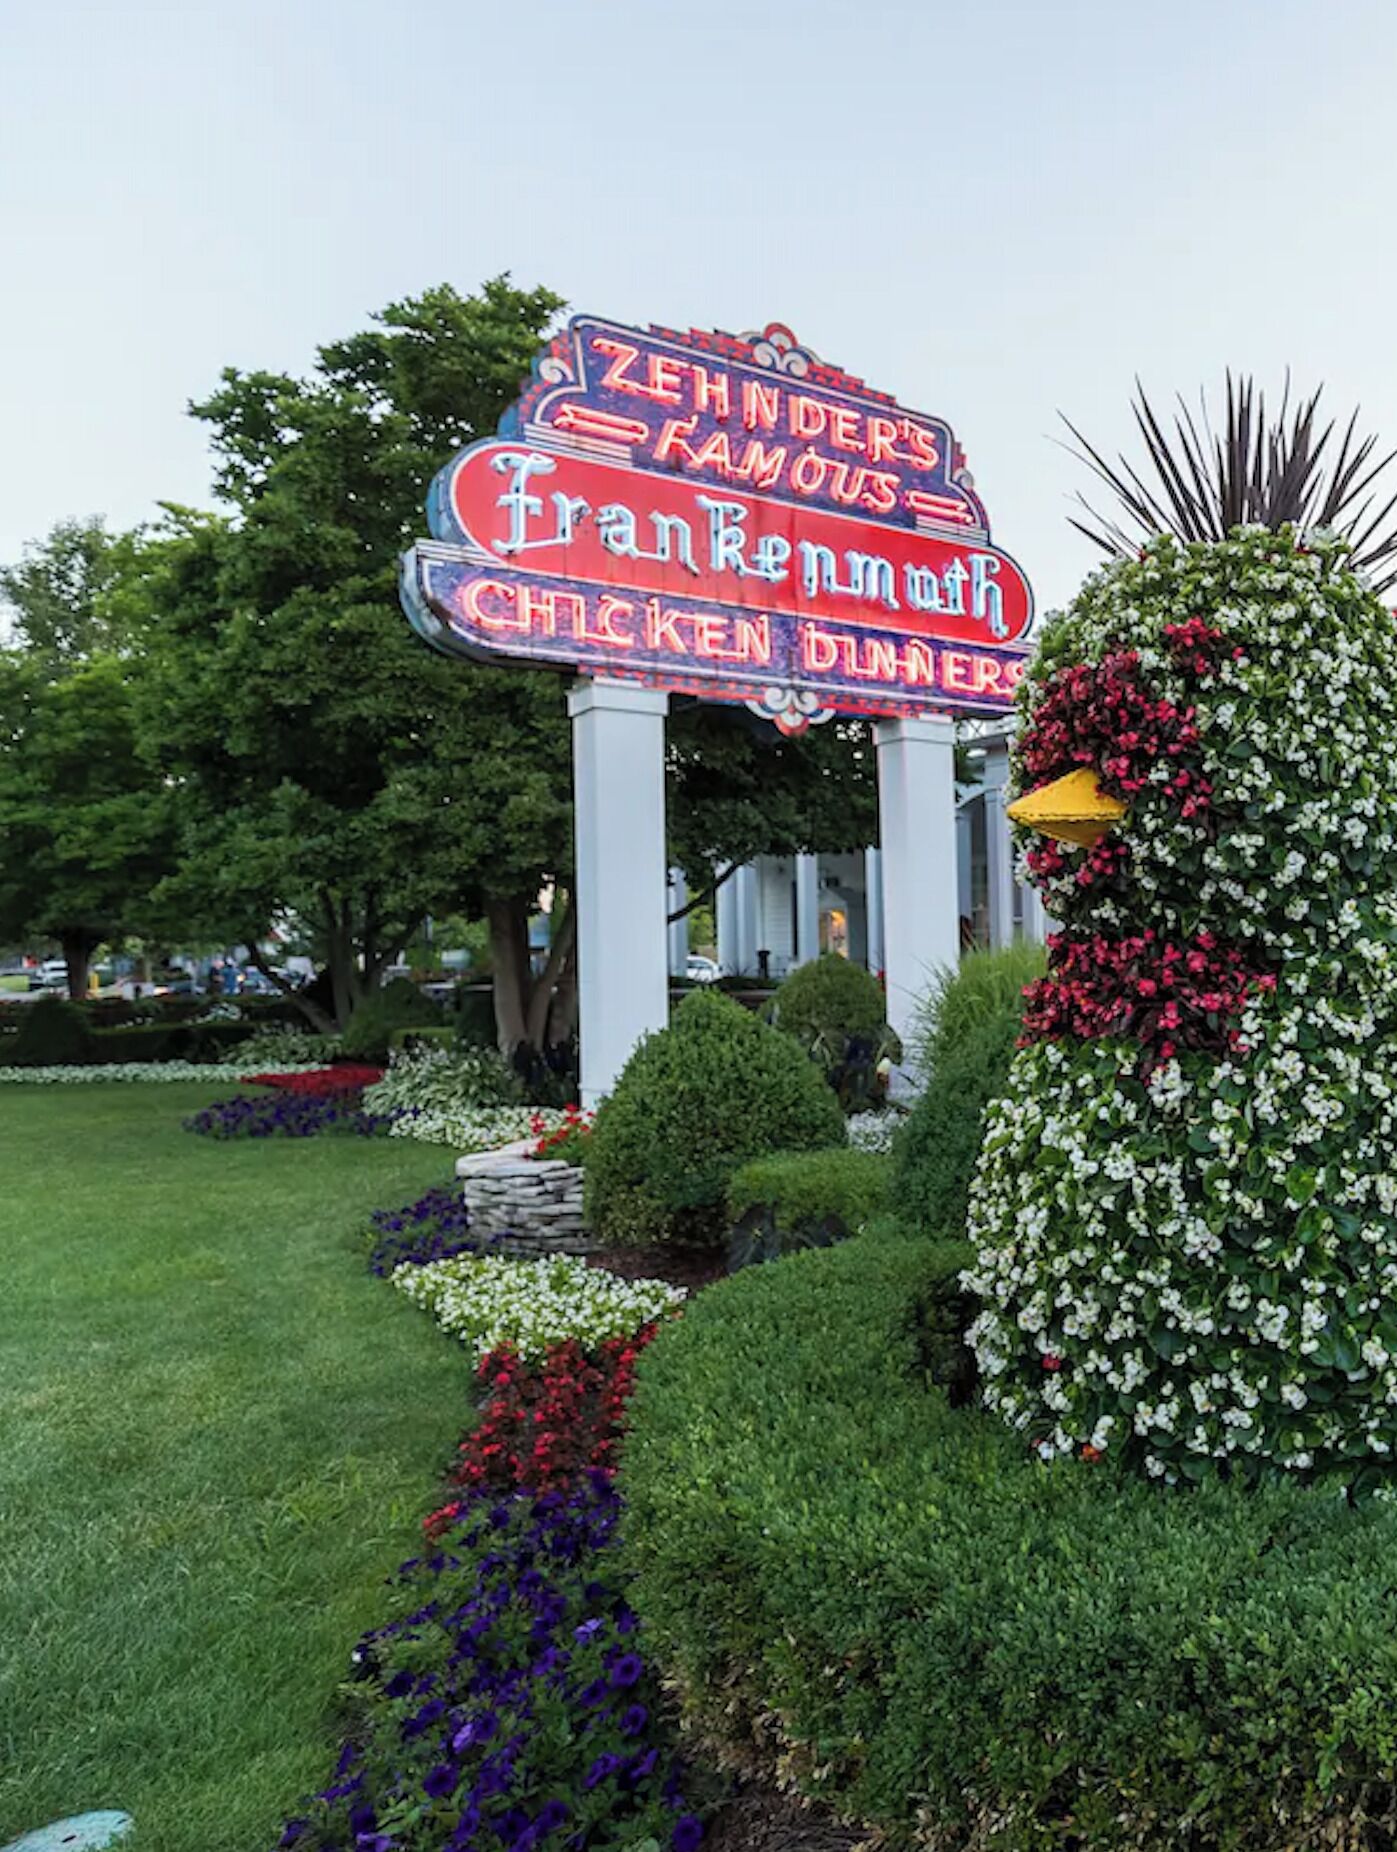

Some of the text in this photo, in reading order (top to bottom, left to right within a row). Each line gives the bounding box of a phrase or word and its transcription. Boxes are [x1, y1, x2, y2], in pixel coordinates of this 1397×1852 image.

[592, 338, 940, 470] ZEHNDER'S
[653, 413, 902, 512] FAMOUS
[490, 453, 1010, 638] Frankenmuth
[458, 579, 772, 665] CHICKEN
